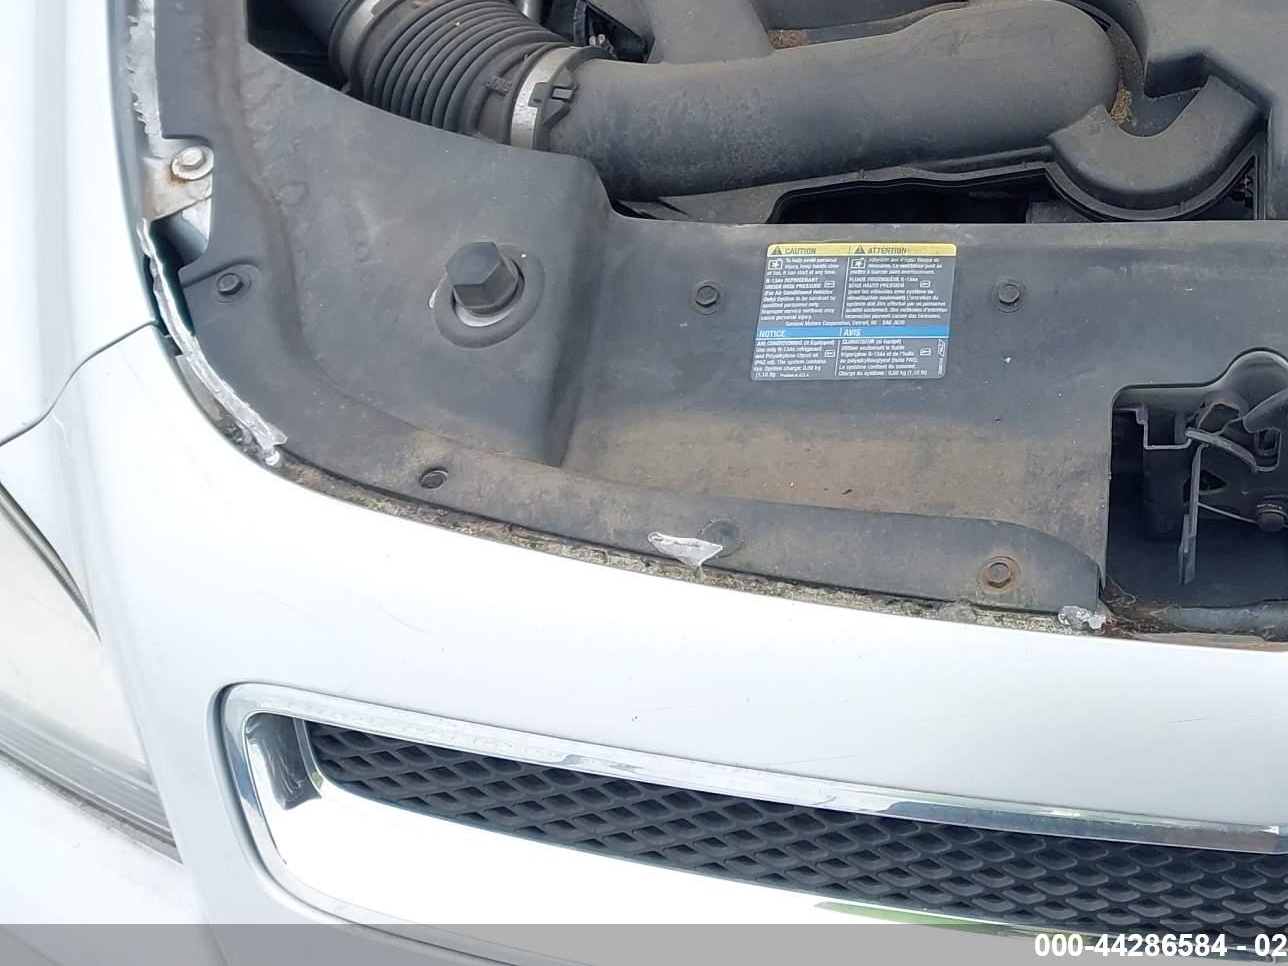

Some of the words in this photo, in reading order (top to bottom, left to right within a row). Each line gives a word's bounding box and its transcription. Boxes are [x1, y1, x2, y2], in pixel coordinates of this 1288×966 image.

[785, 247, 816, 255] CAUTION
[759, 330, 786, 338] NOTICE
[844, 329, 861, 337] AVIS
